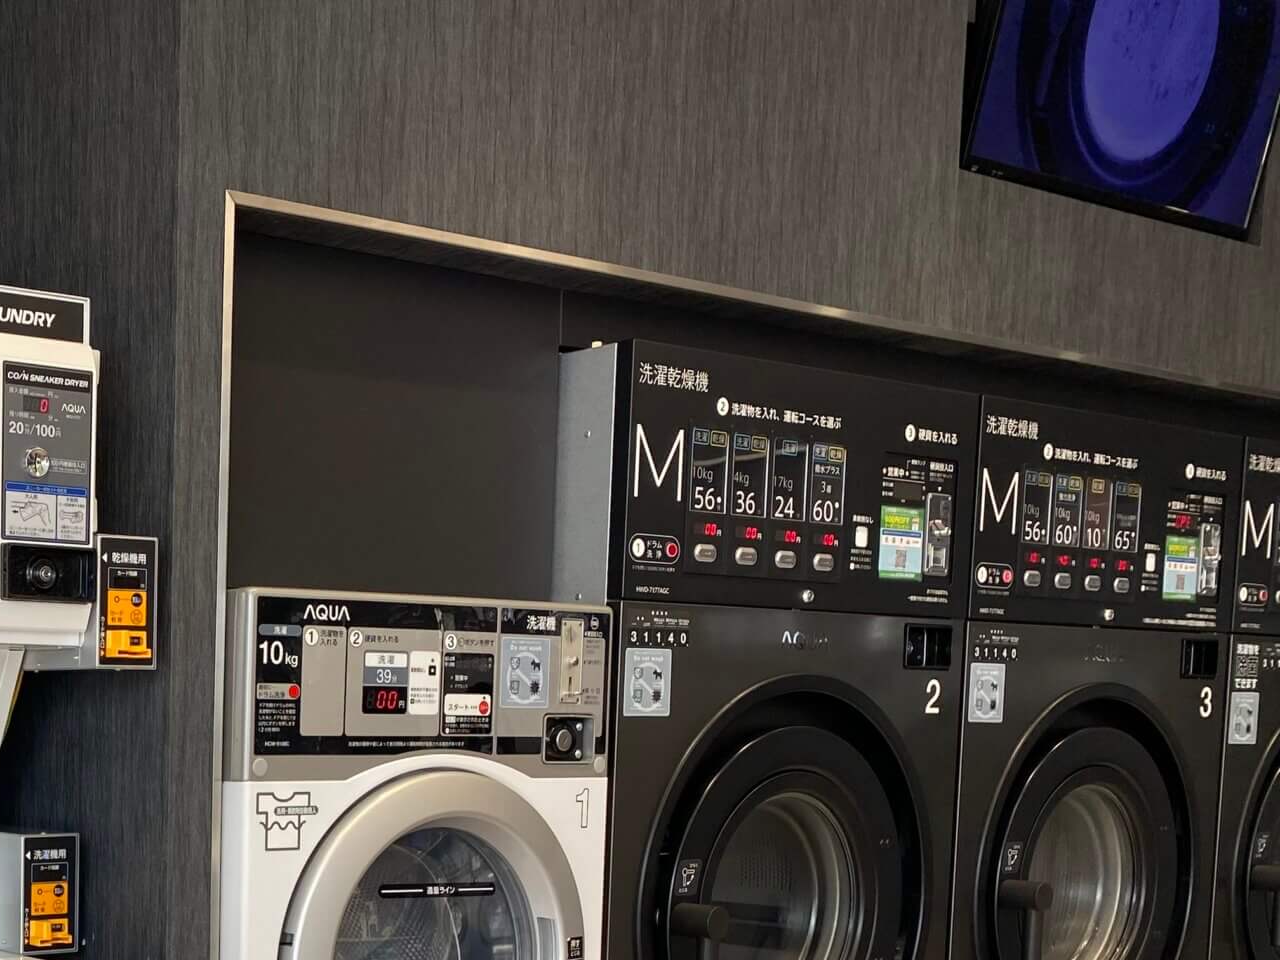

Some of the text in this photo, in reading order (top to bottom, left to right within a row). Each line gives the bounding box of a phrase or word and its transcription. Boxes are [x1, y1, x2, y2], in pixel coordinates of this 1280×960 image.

[29, 374, 64, 385] SNEAKER
[64, 379, 89, 388] DRYER
[639, 361, 709, 392] 洗濯乾燥機
[61, 403, 86, 414] AQUA
[633, 423, 685, 502] M
[694, 486, 715, 510] 56
[735, 490, 756, 514] 36
[774, 495, 795, 518] 24
[979, 467, 1019, 535] M
[813, 500, 834, 522] 60
[1024, 520, 1041, 541] 56
[1055, 524, 1072, 545] 60
[1114, 530, 1130, 550] 65
[1241, 500, 1275, 560] M
[304, 604, 351, 621] AQUA
[924, 679, 941, 714] 2
[1199, 686, 1212, 717] 3
[575, 787, 590, 829] 1
